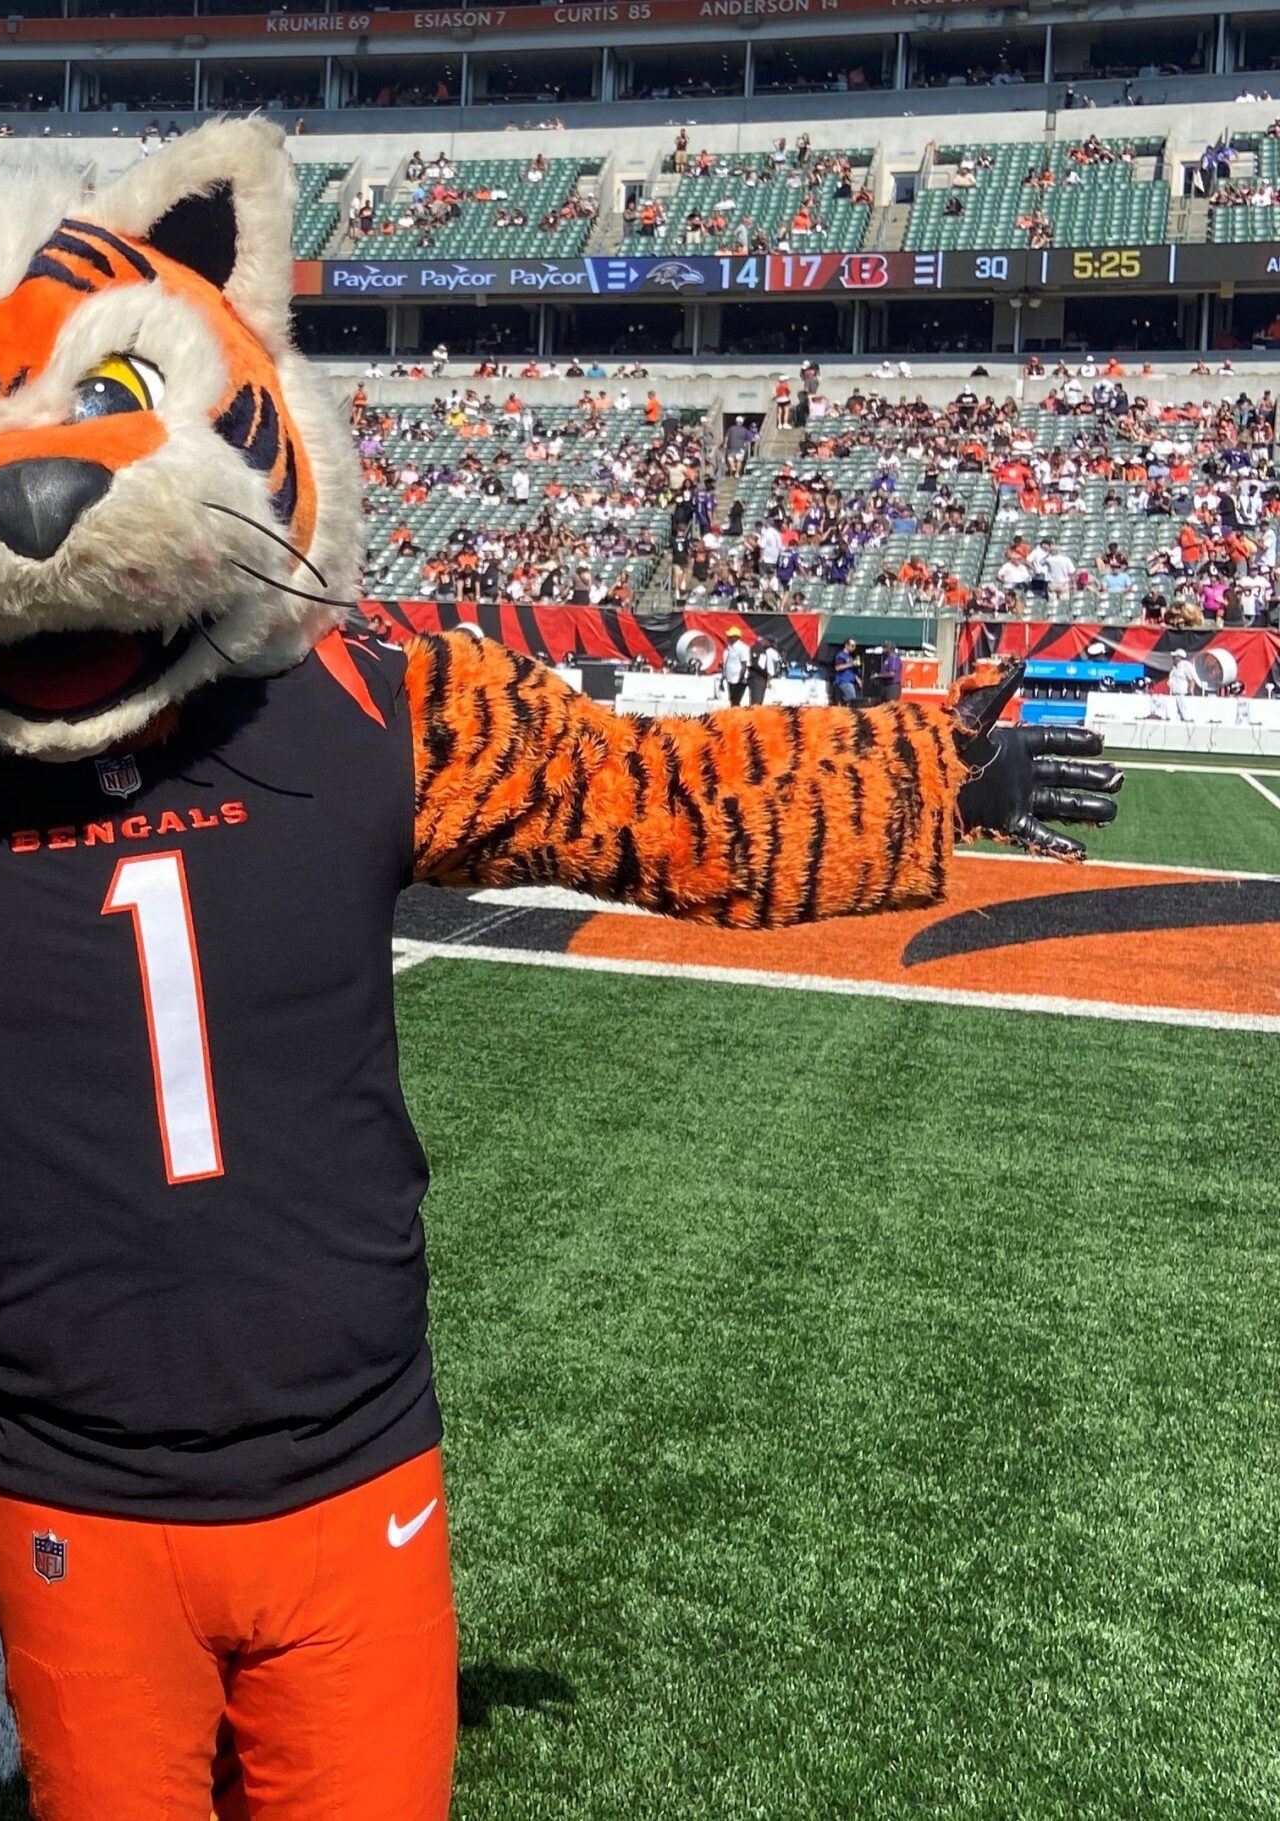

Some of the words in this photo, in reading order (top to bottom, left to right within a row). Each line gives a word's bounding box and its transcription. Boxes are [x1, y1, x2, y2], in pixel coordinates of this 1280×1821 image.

[414, 12, 491, 28] ESIASON
[496, 11, 506, 25] 7
[554, 6, 618, 22] CURTIS
[628, 4, 651, 20] 85
[700, 0, 809, 16] ANDERSON
[266, 16, 344, 32] KRUMRIE
[348, 15, 370, 30] 69
[719, 257, 759, 289] 14
[782, 256, 822, 288] 17
[975, 256, 1008, 279] 3Q
[1073, 250, 1141, 279] 5:25
[333, 270, 408, 291] Paycor
[421, 269, 497, 291] Paycor
[510, 268, 587, 290] Paycor
[11, 800, 249, 853] BENGALS
[100, 849, 225, 1185] 1
